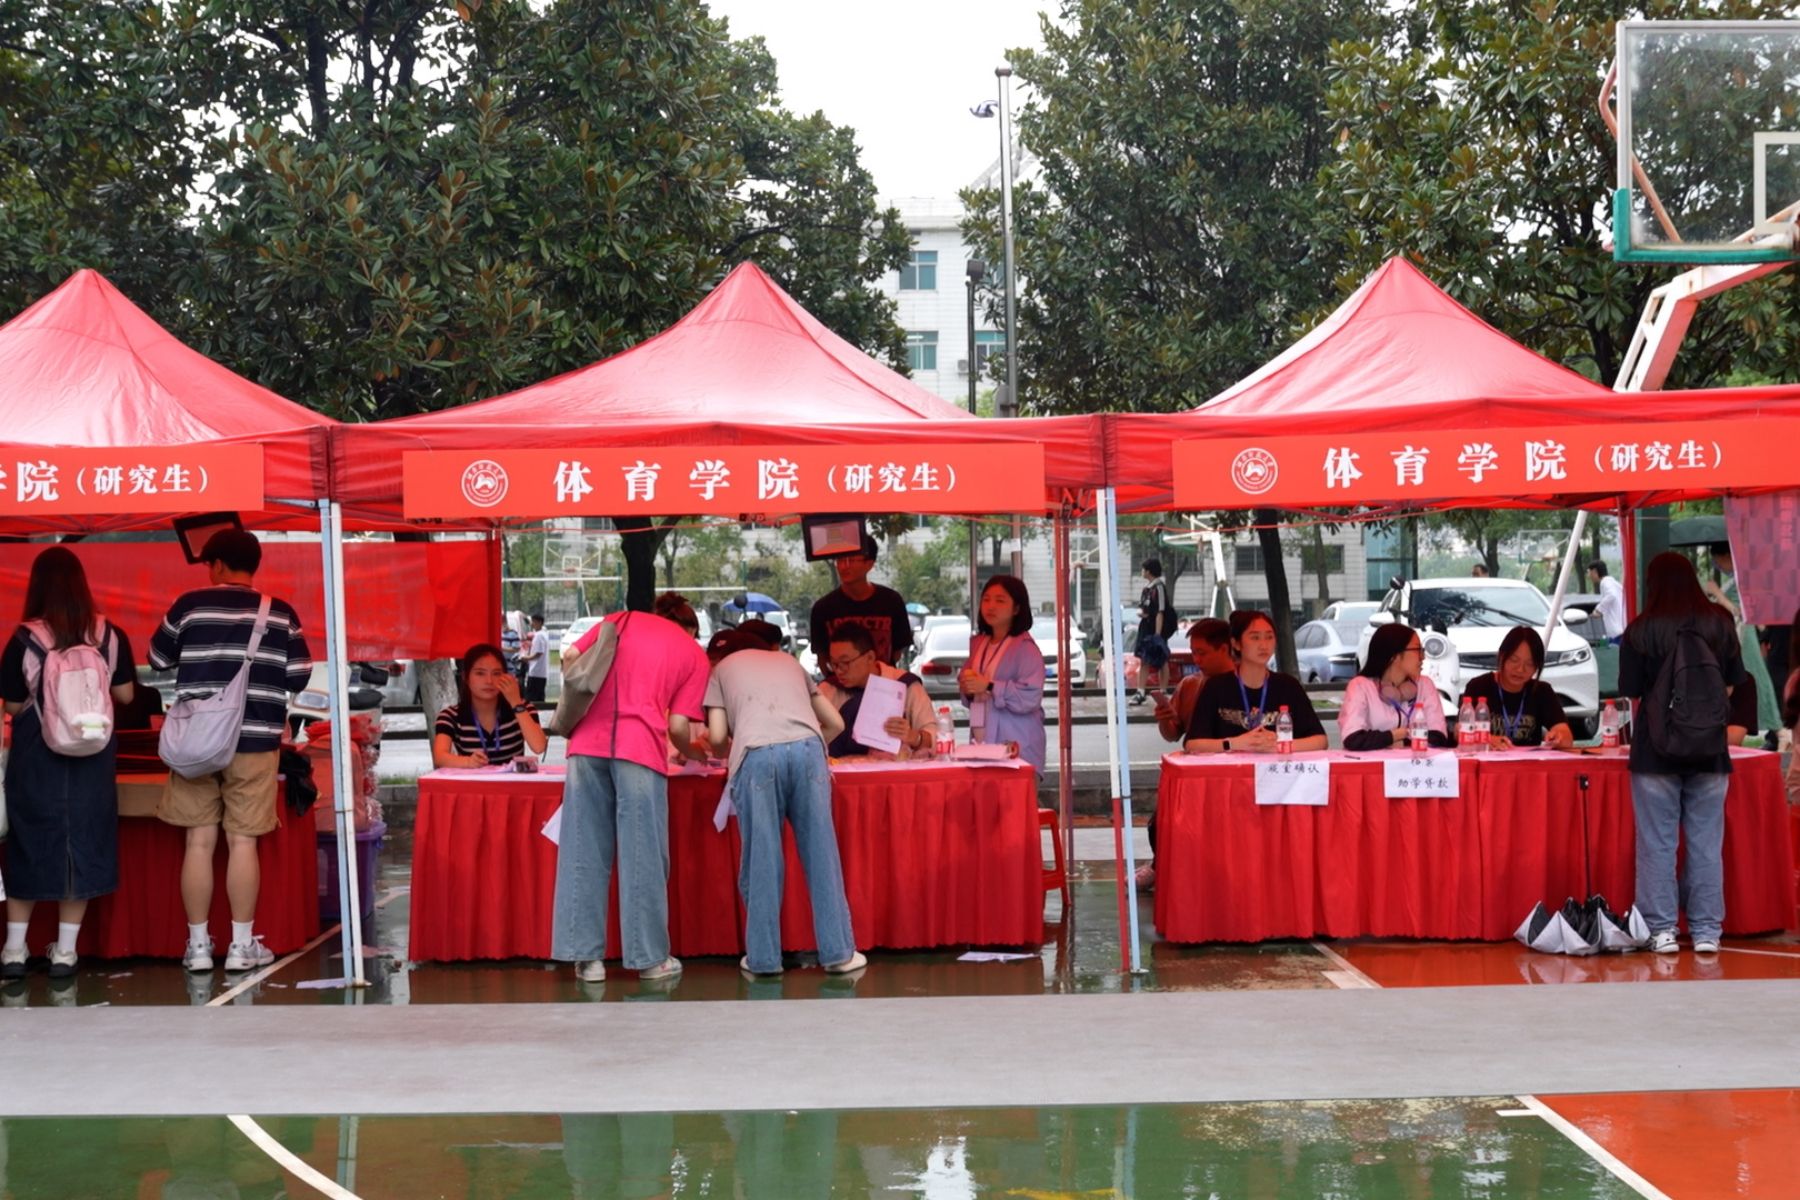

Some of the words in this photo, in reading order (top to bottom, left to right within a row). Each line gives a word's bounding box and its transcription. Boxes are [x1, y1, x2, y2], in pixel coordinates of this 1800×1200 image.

[0, 460, 209, 503] 院（研究生）
[553, 458, 957, 503] 体育学院（研究生）
[1322, 439, 1722, 489] 体育学院（研究生）
